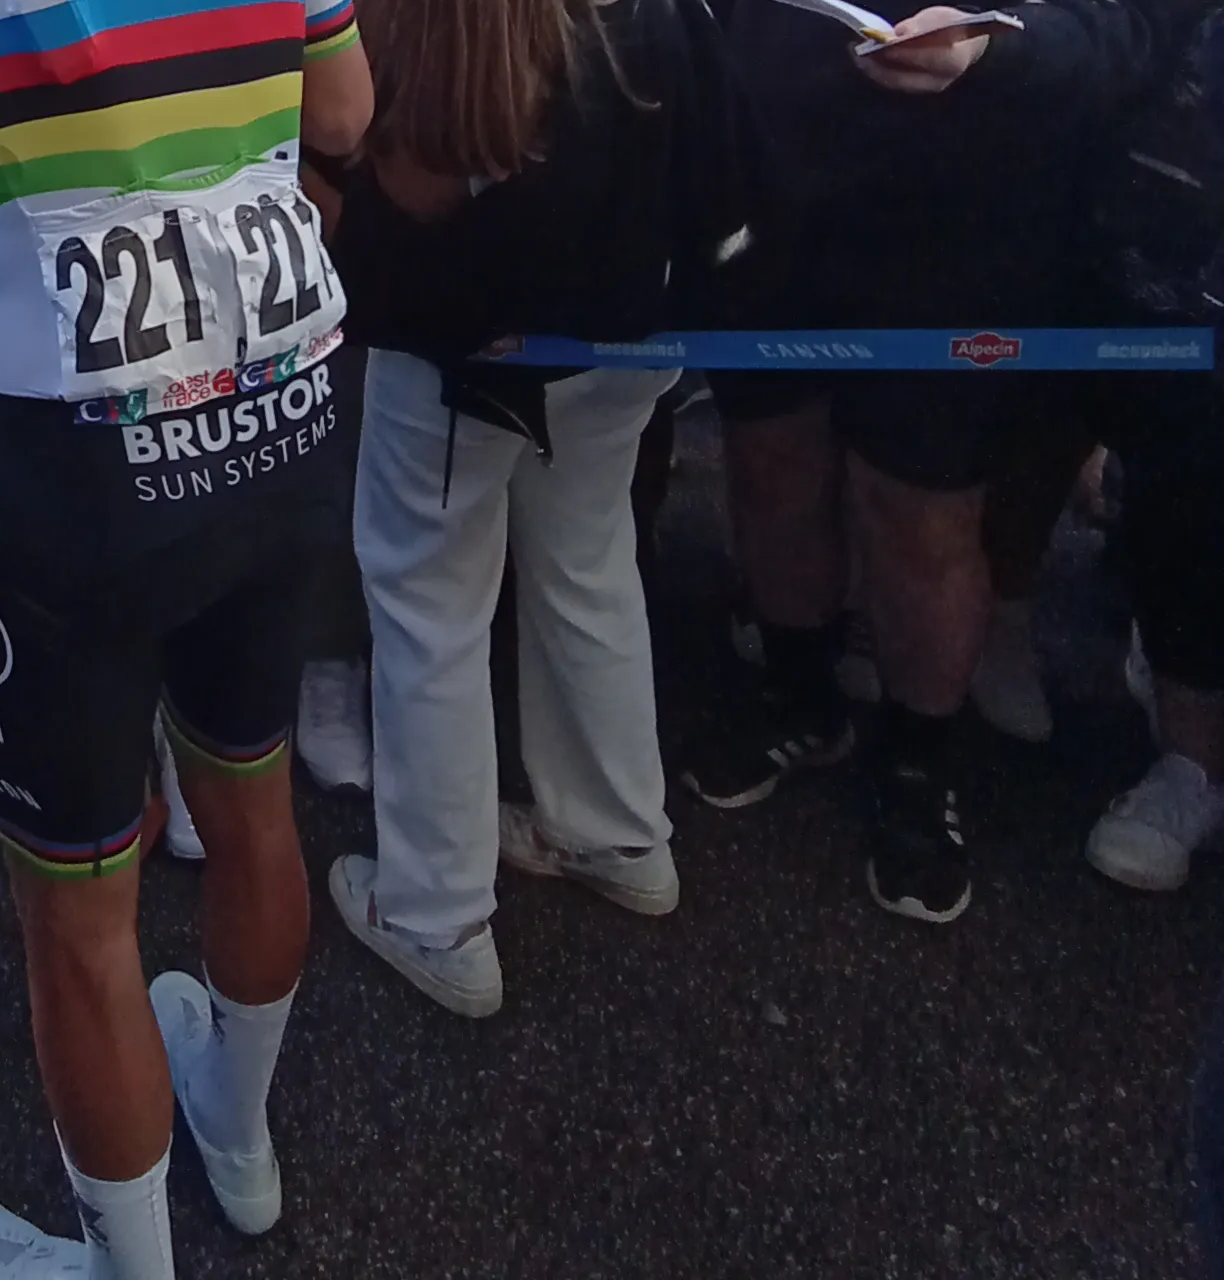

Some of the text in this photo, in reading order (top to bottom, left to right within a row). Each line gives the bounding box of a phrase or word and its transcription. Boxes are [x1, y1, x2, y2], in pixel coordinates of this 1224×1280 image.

[56, 209, 203, 373] 221
[957, 341, 1015, 359] Alpecin
[121, 363, 333, 464] BRUSTOR
[134, 404, 336, 502] SUN SYSTEMS
